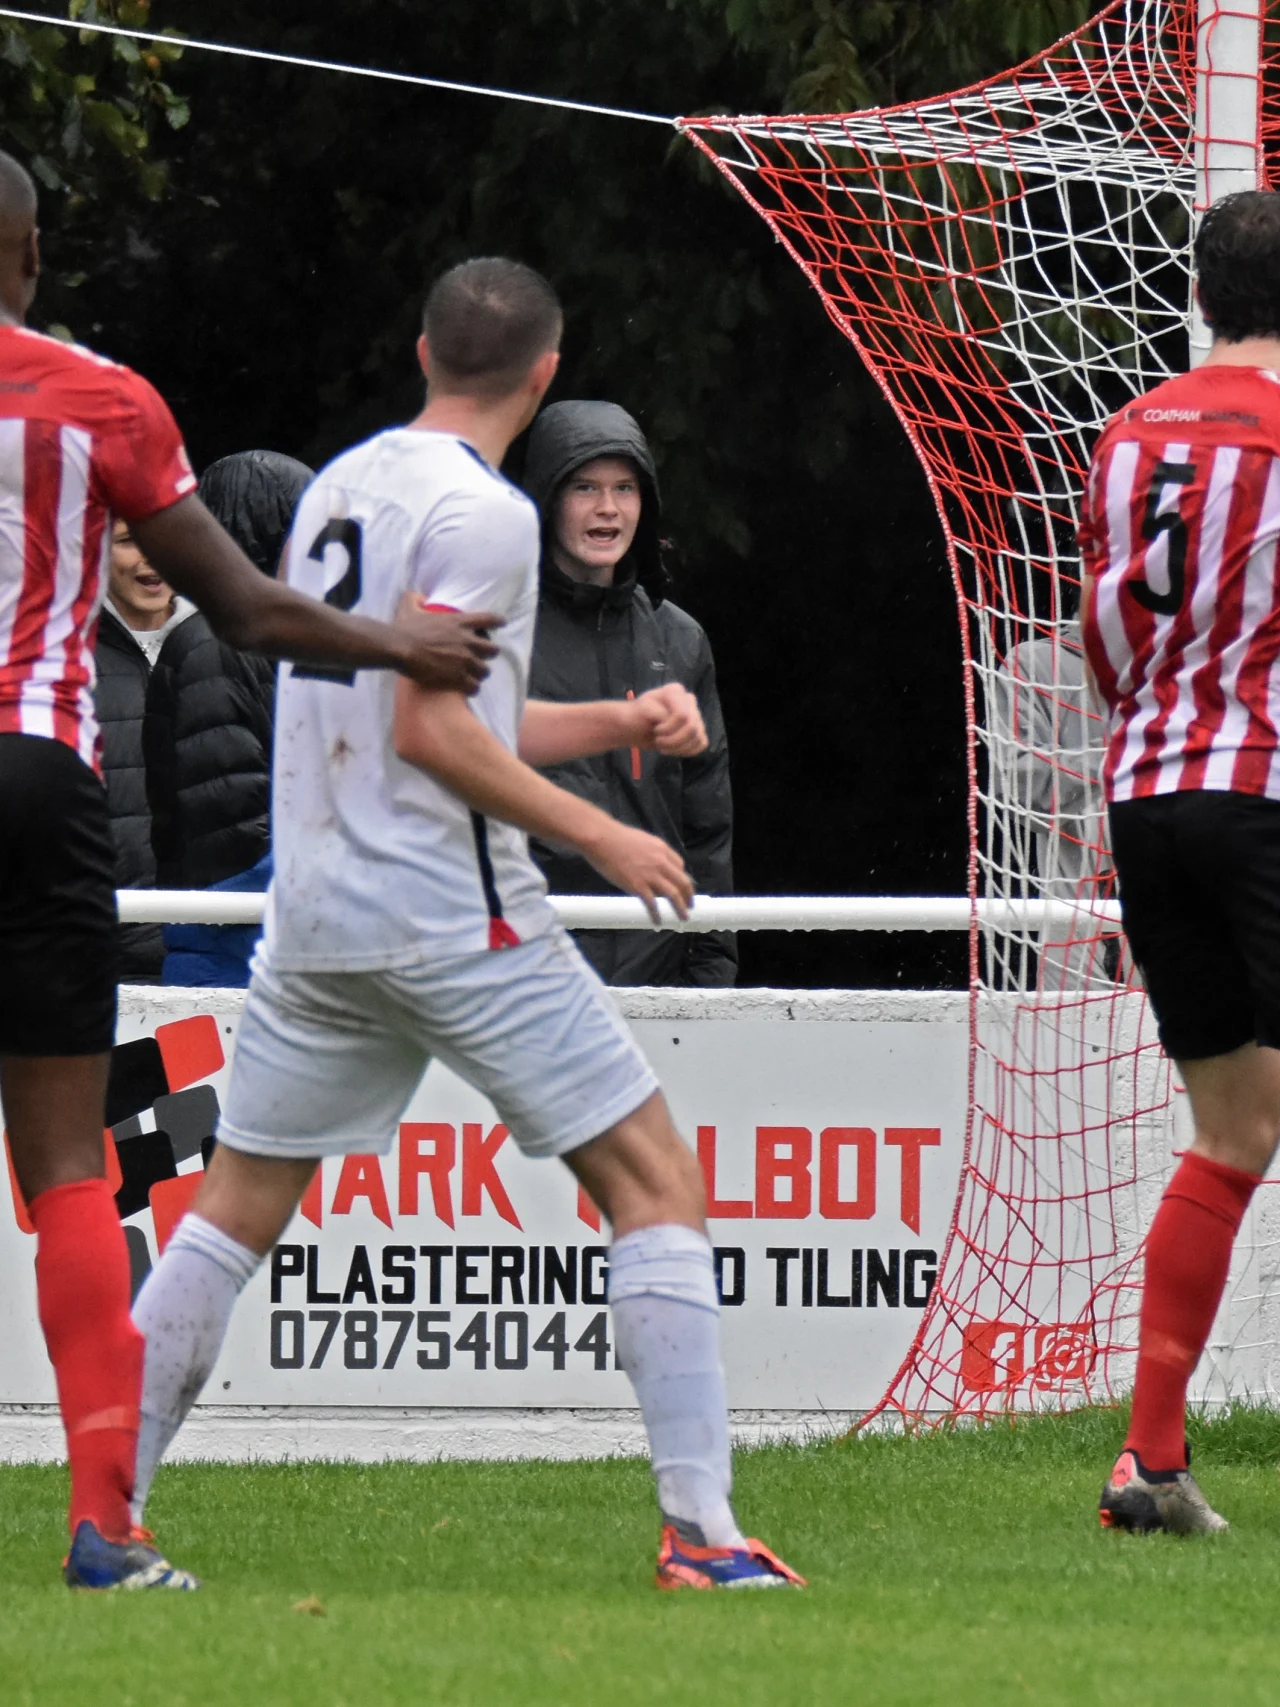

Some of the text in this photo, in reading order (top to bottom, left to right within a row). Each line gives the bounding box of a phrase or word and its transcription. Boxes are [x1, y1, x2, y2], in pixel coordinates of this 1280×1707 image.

[1143, 408, 1199, 423] COATHAM
[1127, 462, 1197, 616] 5
[290, 517, 364, 688] 2
[301, 1122, 941, 1237] ARK LBOT
[270, 1244, 610, 1305] PLASTERING
[766, 1247, 937, 1308] TILING
[270, 1310, 625, 1371] 078754044
